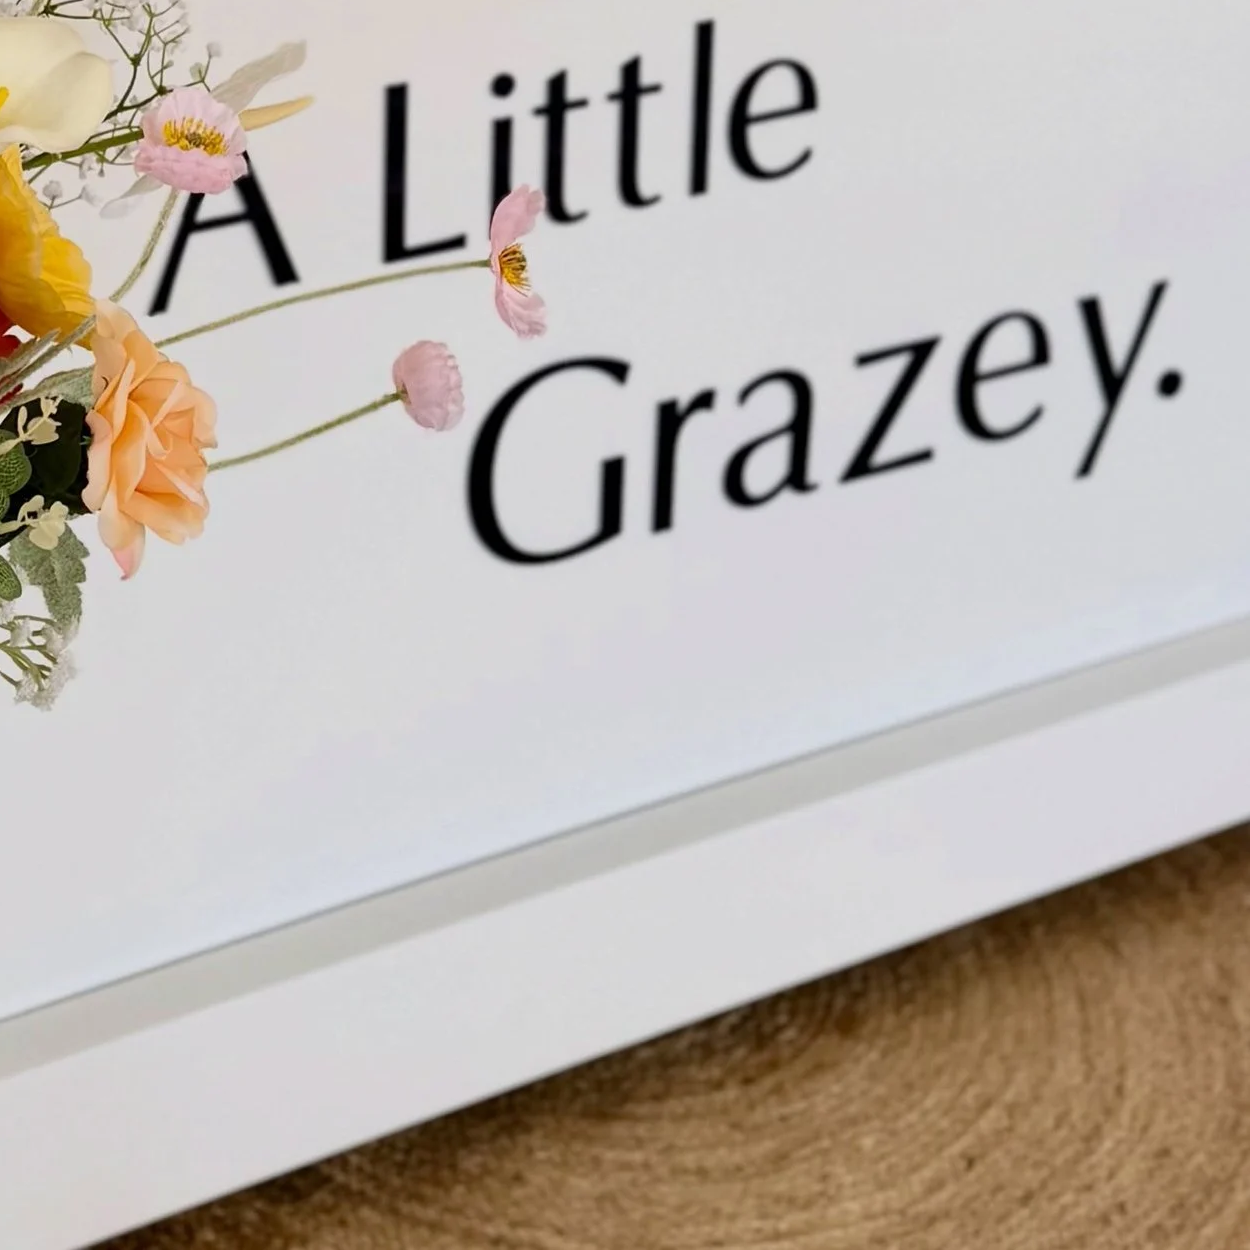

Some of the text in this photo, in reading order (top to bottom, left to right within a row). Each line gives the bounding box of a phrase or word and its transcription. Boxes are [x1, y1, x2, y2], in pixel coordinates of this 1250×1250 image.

[148, 20, 818, 317] A Little
[465, 281, 1183, 566] Grazey.
